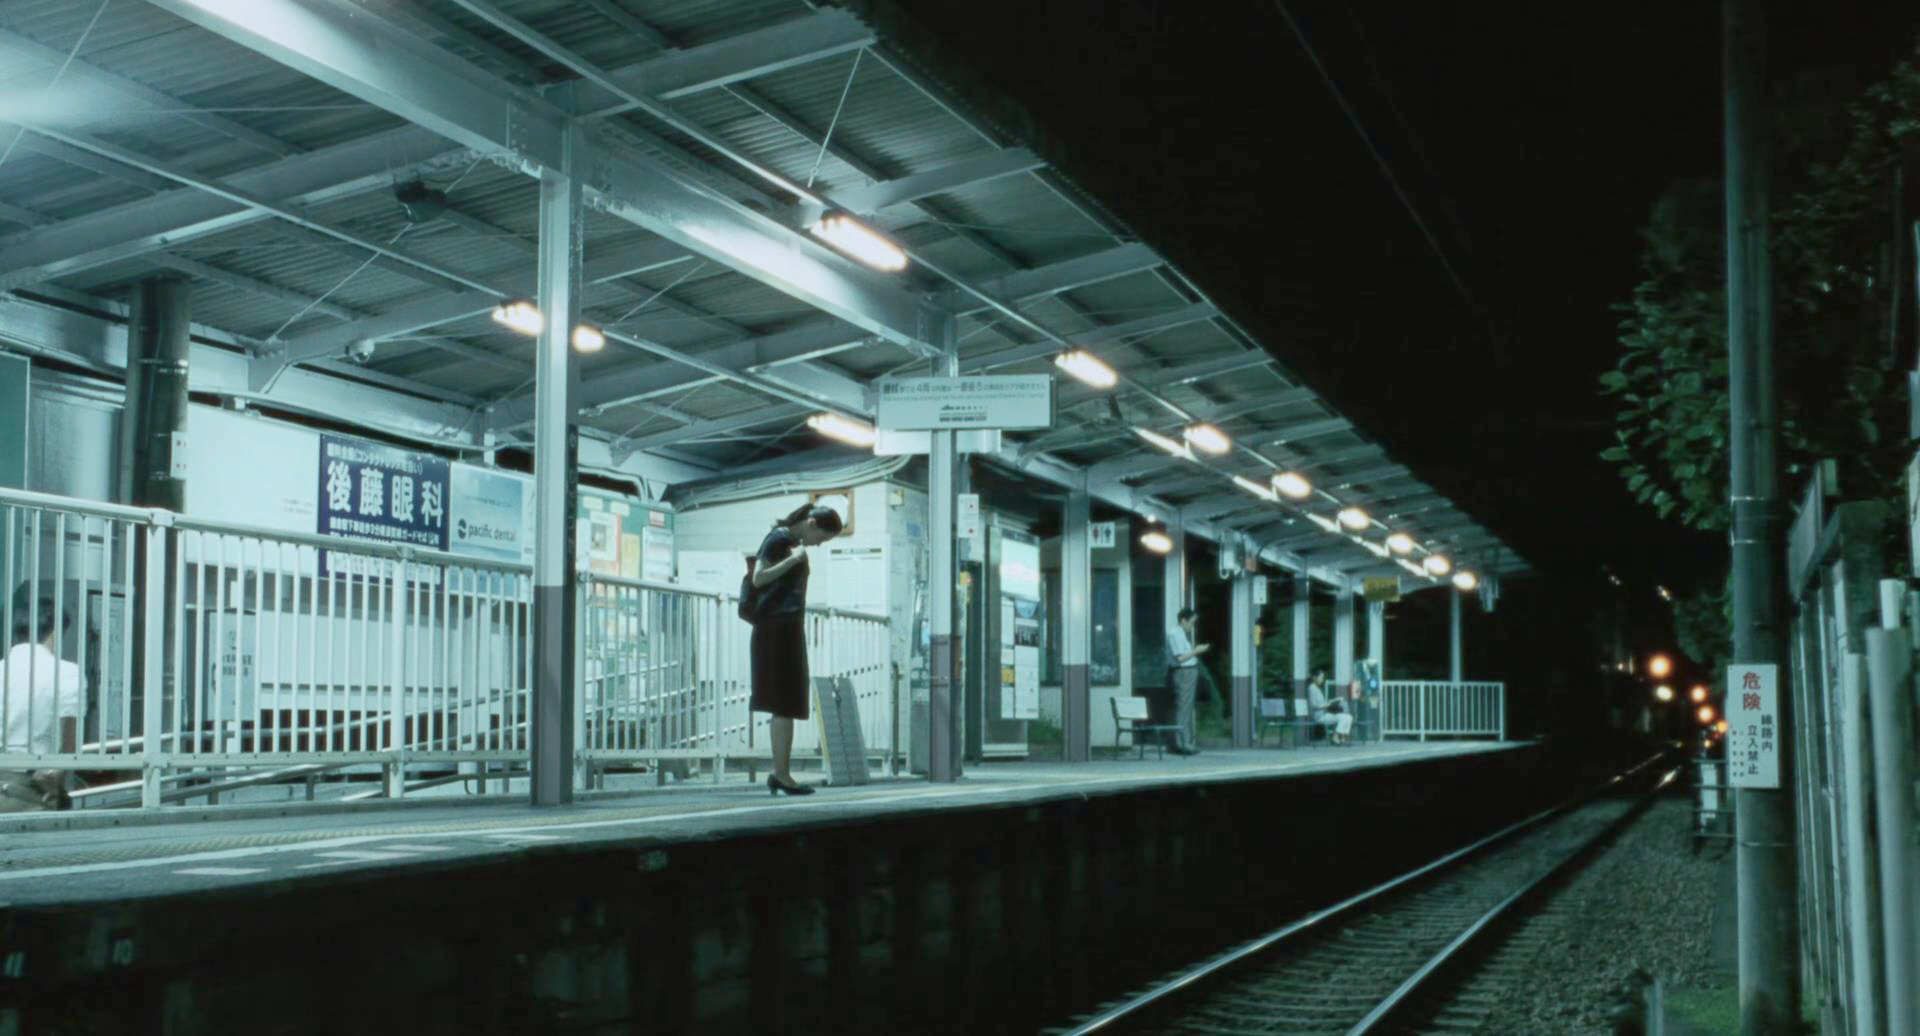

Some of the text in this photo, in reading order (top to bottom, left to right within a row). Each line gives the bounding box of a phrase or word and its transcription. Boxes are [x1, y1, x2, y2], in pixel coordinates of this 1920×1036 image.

[326, 460, 443, 528] 後藤眼科
[468, 523, 516, 542] pacific dental
[1742, 671, 1761, 711] 危険
[1747, 724, 1759, 775] 立入禁止
